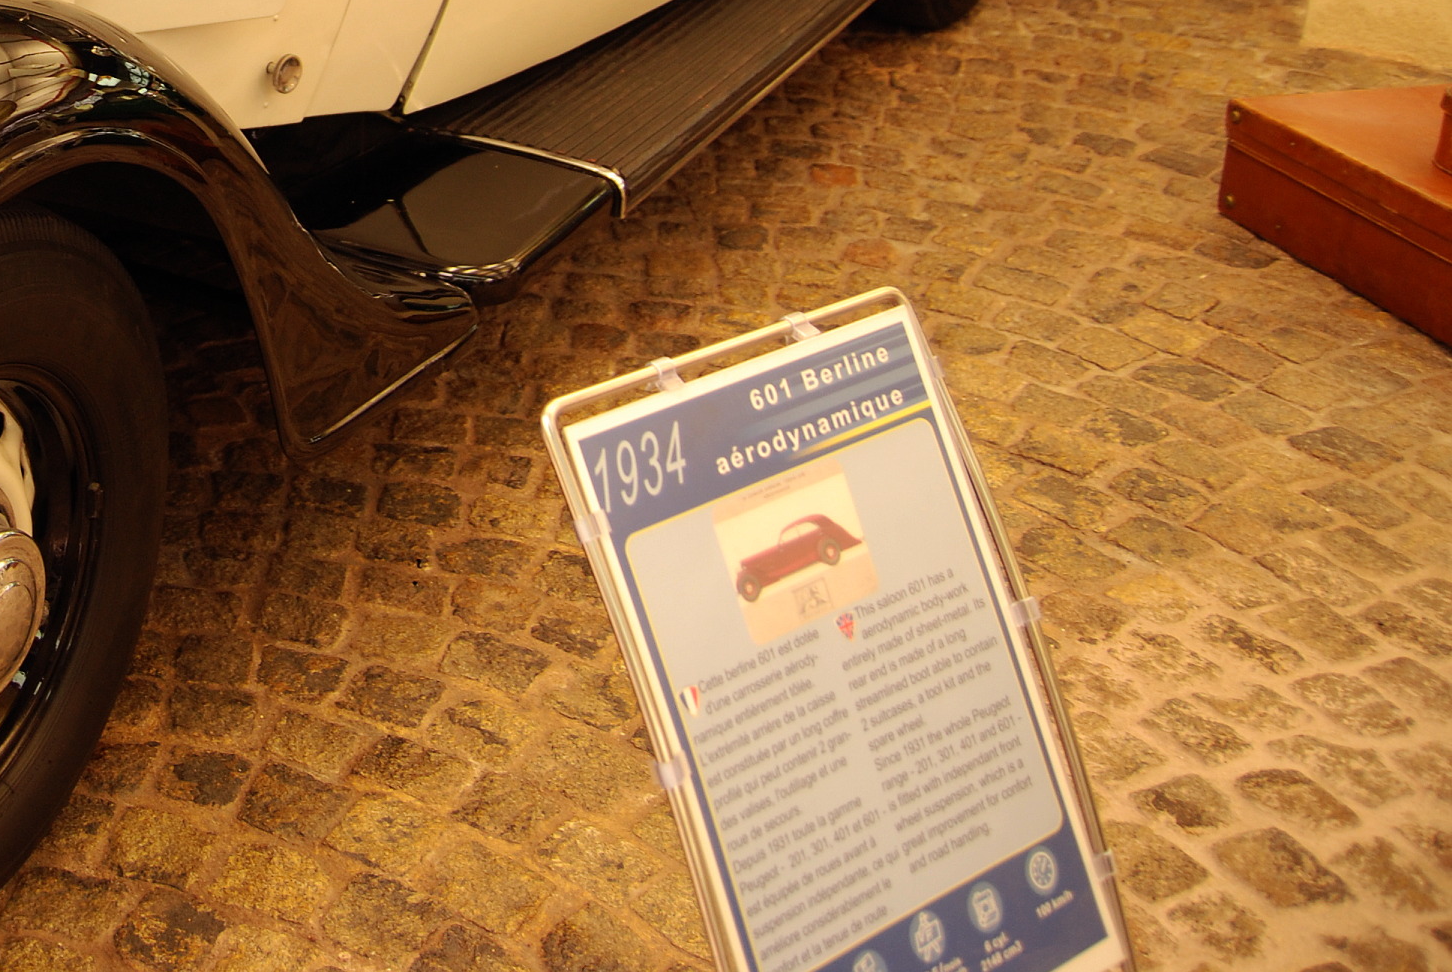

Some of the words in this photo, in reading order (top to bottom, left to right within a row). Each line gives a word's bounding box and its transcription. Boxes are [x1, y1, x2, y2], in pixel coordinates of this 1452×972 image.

[750, 378, 792, 411] 601
[801, 346, 890, 392] Berline
[715, 388, 904, 476] aérodynamique
[594, 420, 687, 513] 1934
[854, 603, 874, 618] This
[876, 590, 907, 609] saloon
[907, 579, 925, 595] 601
[927, 573, 944, 586] has
[946, 569, 953, 577] a
[861, 606, 919, 638] aerodynamic
[919, 581, 968, 611] body-work
[697, 676, 723, 693] Cette
[724, 660, 756, 680] berline
[756, 647, 775, 664] 601
[777, 640, 792, 655] est
[792, 629, 819, 647] dotée
[842, 650, 876, 670] entirely
[877, 637, 903, 654] made
[904, 628, 914, 640] of
[848, 676, 868, 690] rear
[869, 665, 887, 680] end
[888, 661, 897, 671] is
[898, 648, 924, 666] made
[926, 640, 936, 653] of
[937, 640, 944, 648] a
[945, 630, 967, 644] long
[855, 677, 908, 711] streamlined
[909, 667, 930, 683] boot
[931, 659, 951, 673] able
[952, 654, 962, 663] to
[964, 636, 997, 658] contain
[693, 719, 733, 743] namique
[734, 689, 788, 724] entièrement
[704, 697, 731, 713] d'une
[732, 669, 781, 700] carrosserie
[751, 720, 781, 739] arrière
[781, 711, 795, 723] de
[795, 705, 805, 715] la
[806, 692, 836, 711] caisse
[861, 719, 868, 730] 2
[917, 695, 924, 703] a
[925, 683, 942, 699] tool
[943, 678, 955, 690] kit
[956, 667, 974, 683] and
[975, 662, 990, 674] the
[707, 772, 722, 787] est
[723, 748, 770, 779] constituée
[771, 739, 786, 756] par
[788, 733, 801, 744] un
[800, 722, 822, 737] long
[822, 709, 848, 727] coffre
[868, 733, 895, 751] spare
[874, 753, 902, 770] Since
[903, 737, 925, 755] 1931
[927, 731, 942, 744] the
[943, 716, 971, 735] whole
[971, 695, 1010, 720] Peugeot
[881, 773, 908, 790] range
[958, 733, 976, 749] 401
[978, 724, 996, 741] and
[997, 715, 1014, 732] 601
[713, 785, 742, 810] profilé
[743, 775, 758, 794] qui
[759, 766, 781, 786] peut
[782, 746, 817, 771] contenir
[818, 741, 826, 753] 2
[719, 816, 738, 830] des
[818, 764, 828, 777] et
[829, 758, 847, 771] une
[887, 801, 896, 811] is
[897, 786, 920, 805] fitted
[922, 775, 941, 792] with
[998, 736, 1021, 753] front
[895, 809, 922, 830] wheel
[979, 765, 1005, 786] which
[1006, 762, 1015, 772] is
[1017, 760, 1023, 768] a
[726, 835, 748, 850] roue
[748, 827, 762, 838] de
[732, 851, 766, 873] Depuis
[768, 834, 789, 853] 1931
[791, 823, 816, 840] toute
[815, 816, 826, 826] la
[827, 798, 861, 824] gamme
[738, 865, 778, 893] Peugeot
[832, 825, 850, 841] 401
[852, 820, 861, 832] et
[861, 808, 879, 826] 601
[901, 833, 925, 854] great
[925, 800, 985, 838] improvement
[985, 794, 999, 806] for
[746, 900, 761, 916] est
[761, 881, 800, 907] équipée
[800, 873, 813, 885] de
[815, 858, 841, 877] roues
[843, 841, 867, 862] avant
[868, 835, 876, 847] à
[871, 858, 883, 869] ce
[884, 846, 899, 866] qui
[880, 879, 892, 889] le
[909, 855, 926, 872] and
[928, 842, 949, 861] road
[801, 948, 810, 961] et
[811, 945, 821, 955] la
[822, 928, 848, 948] tenue
[849, 920, 862, 932] de
[864, 907, 887, 926] route
